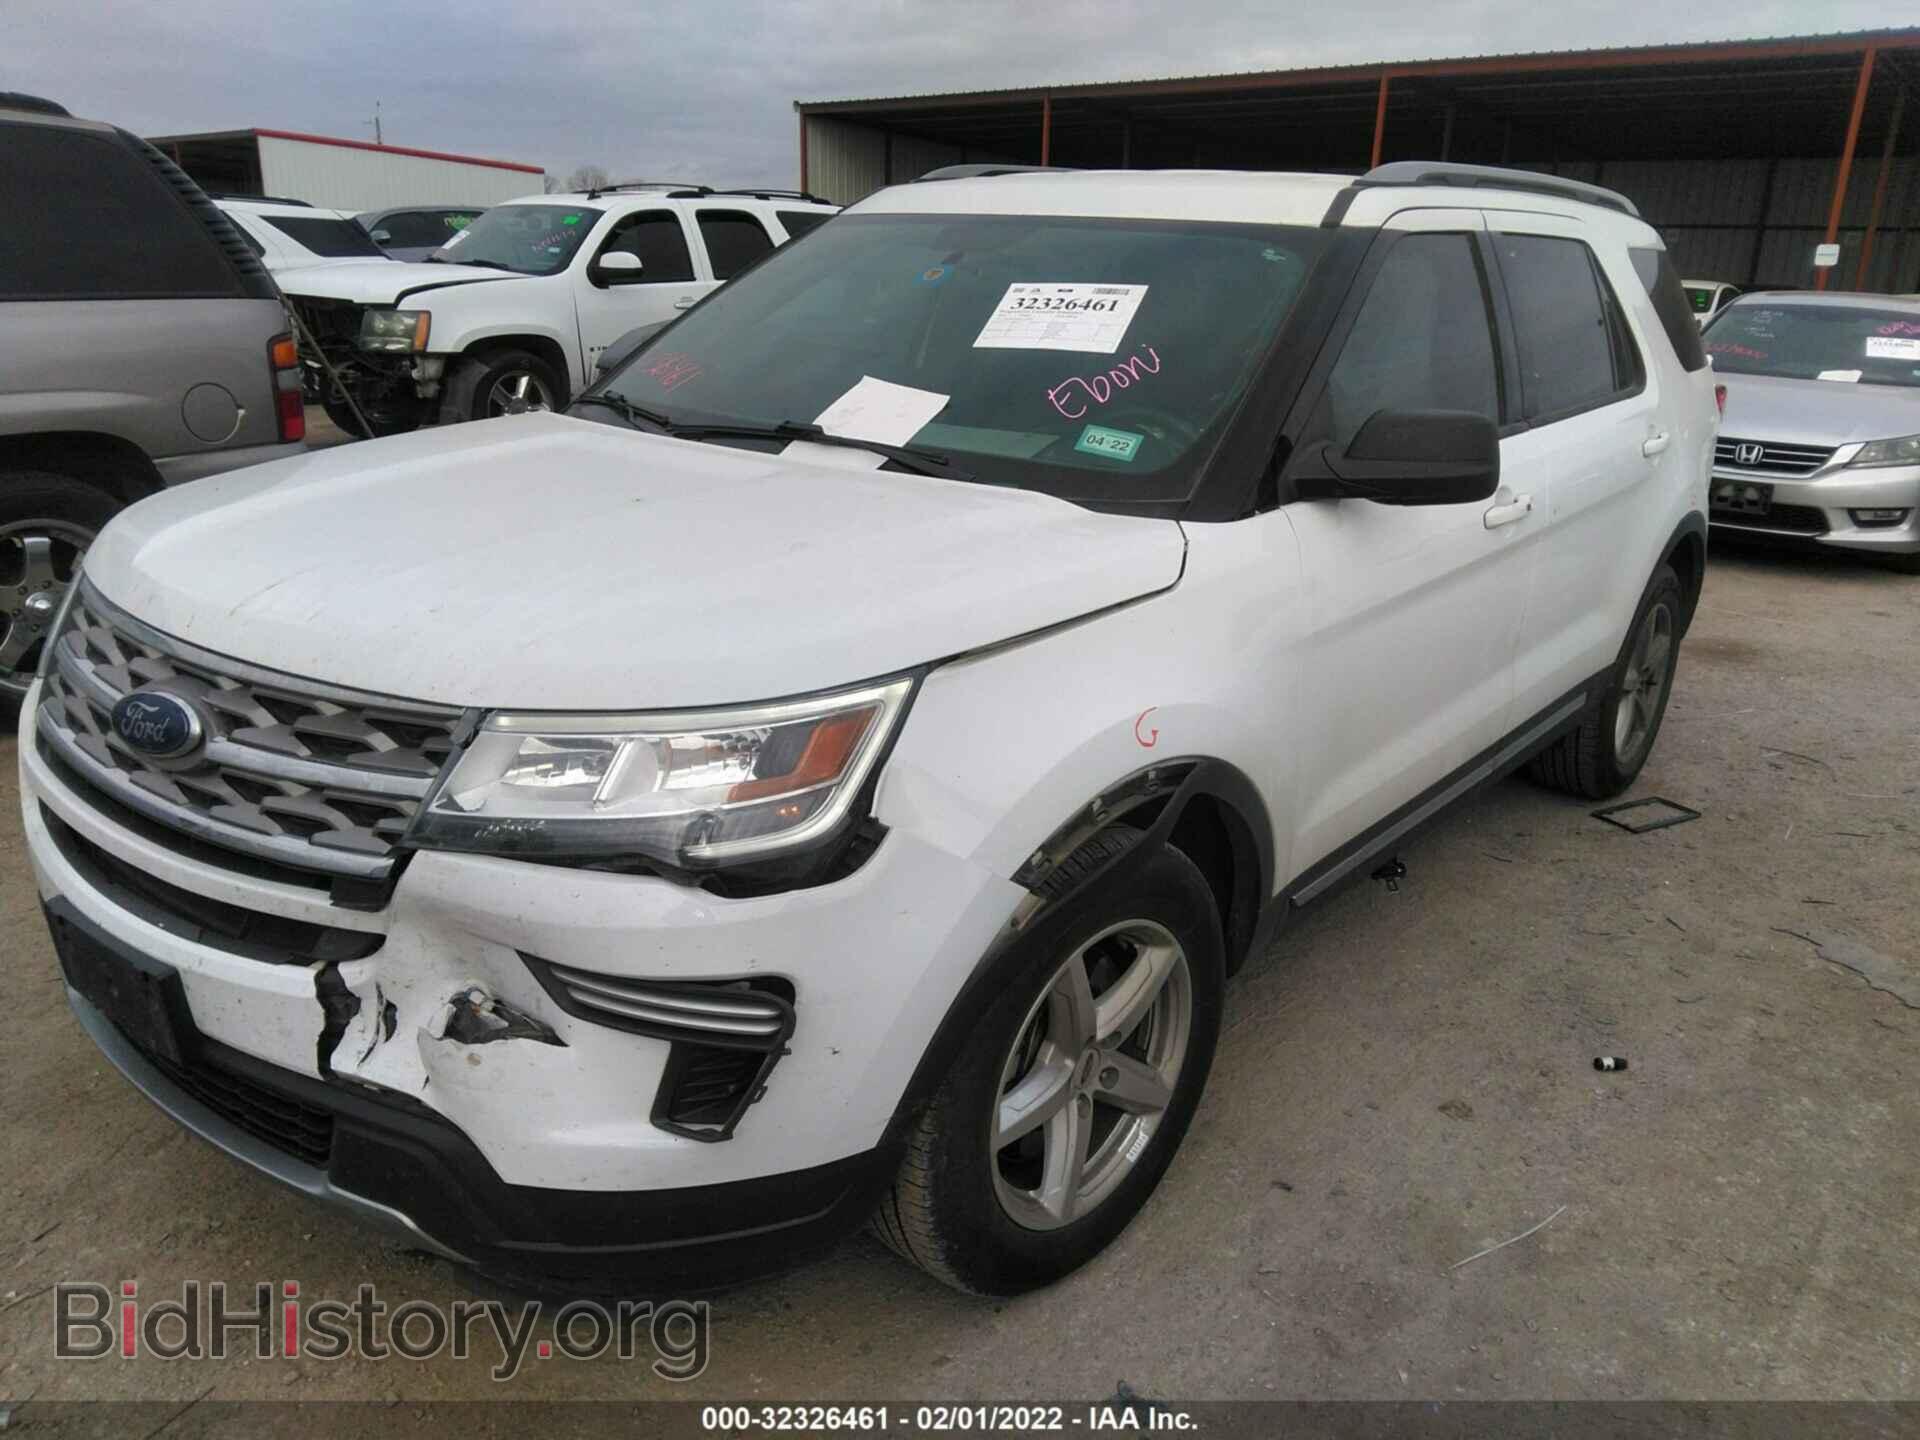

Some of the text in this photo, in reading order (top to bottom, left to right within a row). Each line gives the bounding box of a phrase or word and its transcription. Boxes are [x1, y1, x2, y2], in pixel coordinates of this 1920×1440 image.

[1010, 297, 1120, 312] 32326461
[1086, 434, 1131, 451] 04 22
[121, 701, 170, 743] Ford
